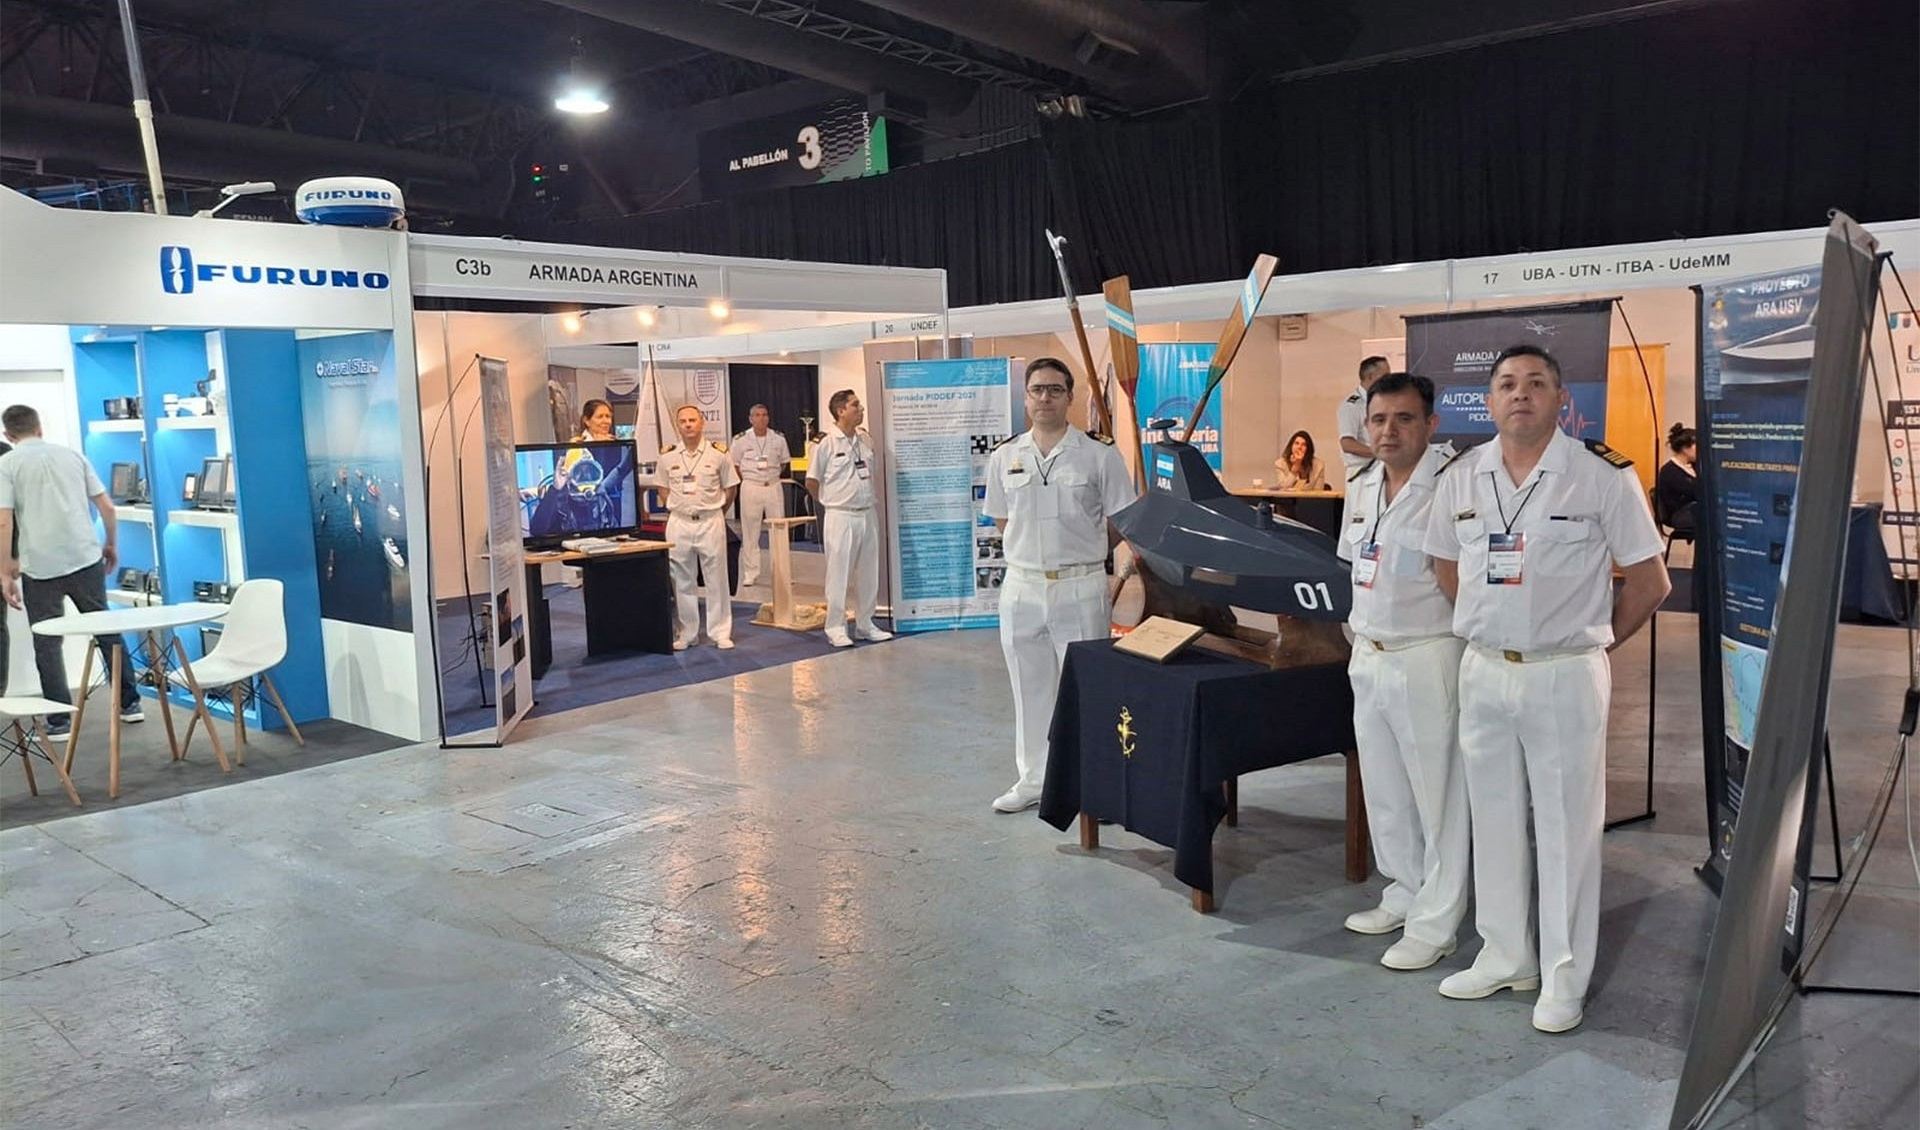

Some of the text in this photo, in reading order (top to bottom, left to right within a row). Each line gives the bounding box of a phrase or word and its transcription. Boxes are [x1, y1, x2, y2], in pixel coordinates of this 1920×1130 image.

[797, 125, 822, 170] 3
[729, 149, 789, 171] AL PABELLÓN
[865, 157, 872, 171] TO
[305, 190, 391, 202] FURUNO
[197, 264, 390, 289] FURUNO
[456, 258, 698, 288] C3b ARMADA ARGENTINA
[1484, 273, 1499, 285] 17
[1523, 267, 1556, 281] UBA
[1569, 264, 1601, 278] UTN
[1616, 260, 1654, 275] ITBA
[1669, 253, 1731, 271] UdeMM
[1755, 297, 1804, 318] ARA USV
[910, 320, 938, 331] UNDEF
[1455, 351, 1495, 362] ARMADA
[1441, 392, 1487, 405] AUTOPIL
[700, 409, 721, 421] NTI
[1156, 476, 1172, 491] ARA
[1293, 582, 1335, 612] 01
